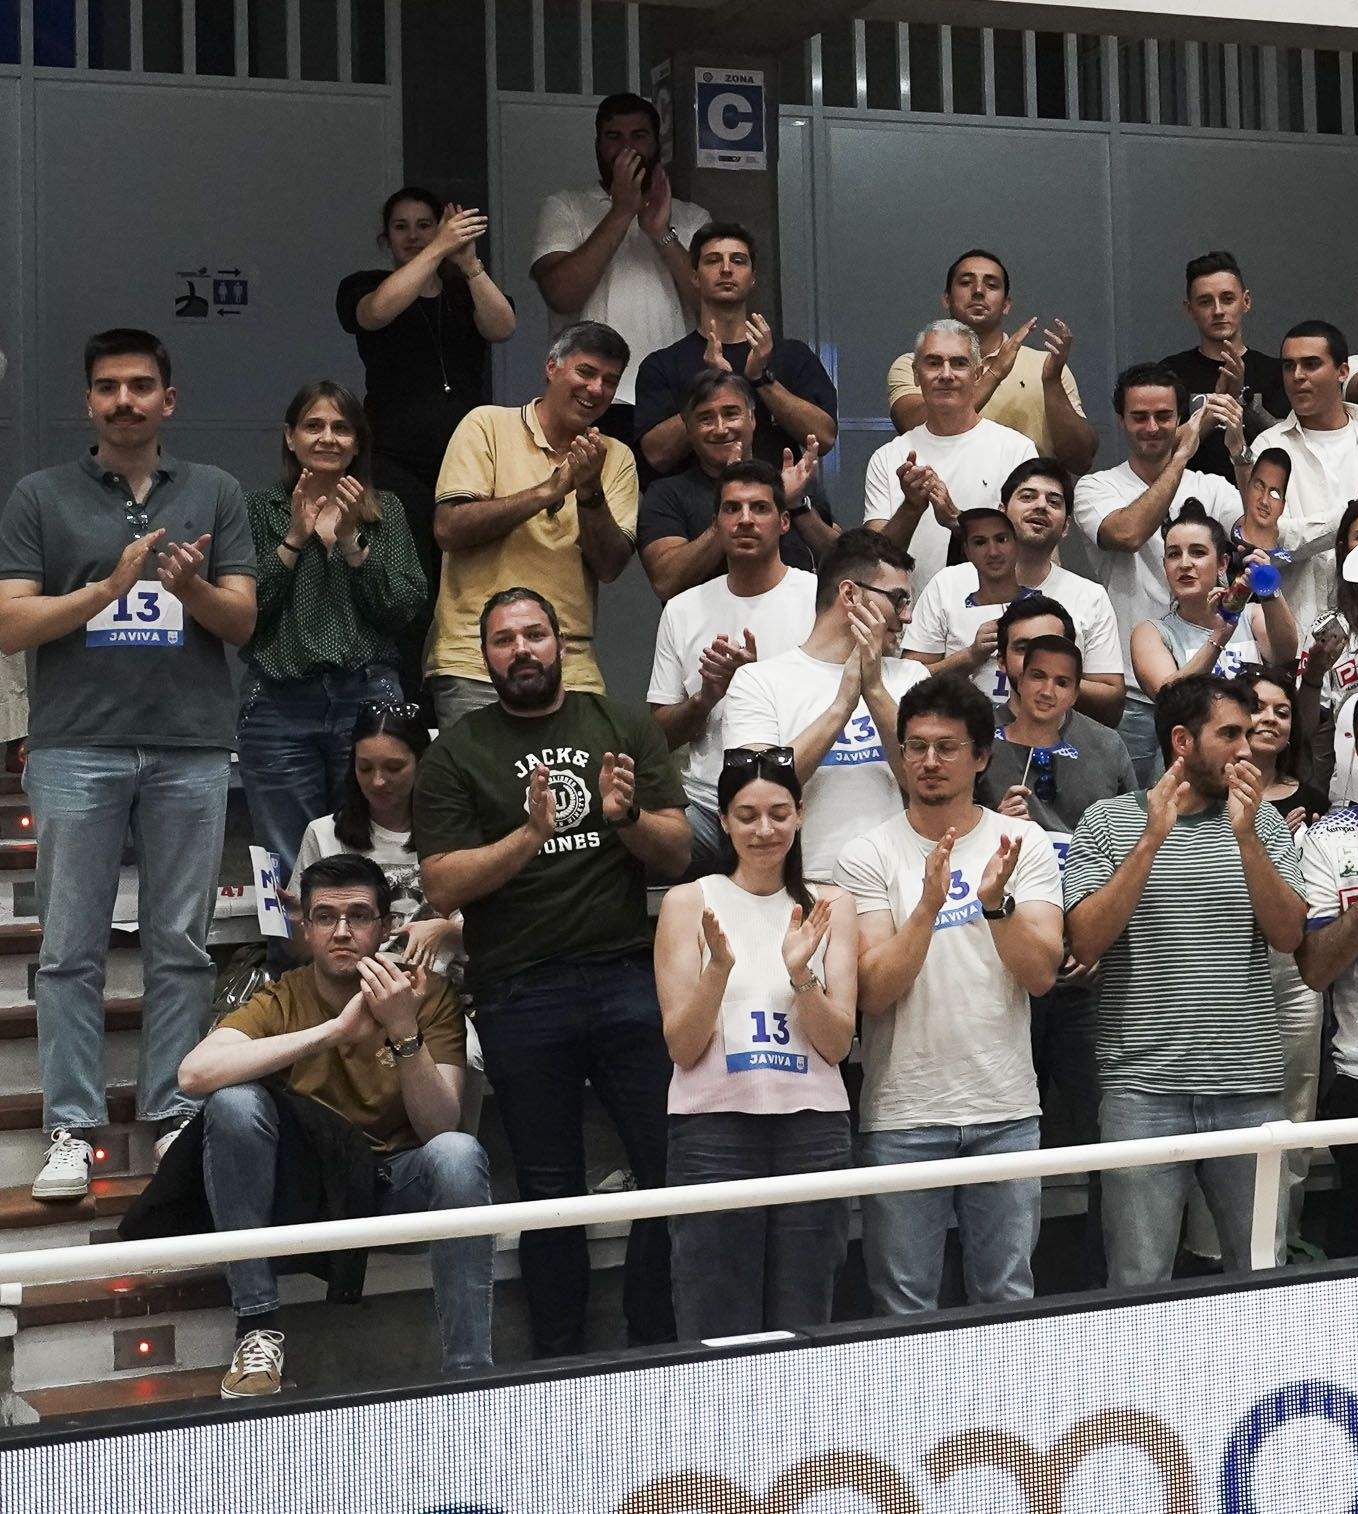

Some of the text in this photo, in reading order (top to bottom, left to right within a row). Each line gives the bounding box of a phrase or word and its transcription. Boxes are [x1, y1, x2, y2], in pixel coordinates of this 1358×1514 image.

[725, 74, 754, 83] ZONA
[708, 92, 753, 141] C
[112, 591, 161, 623] 13
[109, 631, 161, 642] JAVIVA
[835, 749, 881, 762] JAVIVA
[538, 832, 601, 856] ONES
[1052, 842, 1071, 872] 3
[949, 869, 970, 901] 3
[750, 1010, 790, 1046] 13
[749, 1053, 792, 1067] JAVIVA
